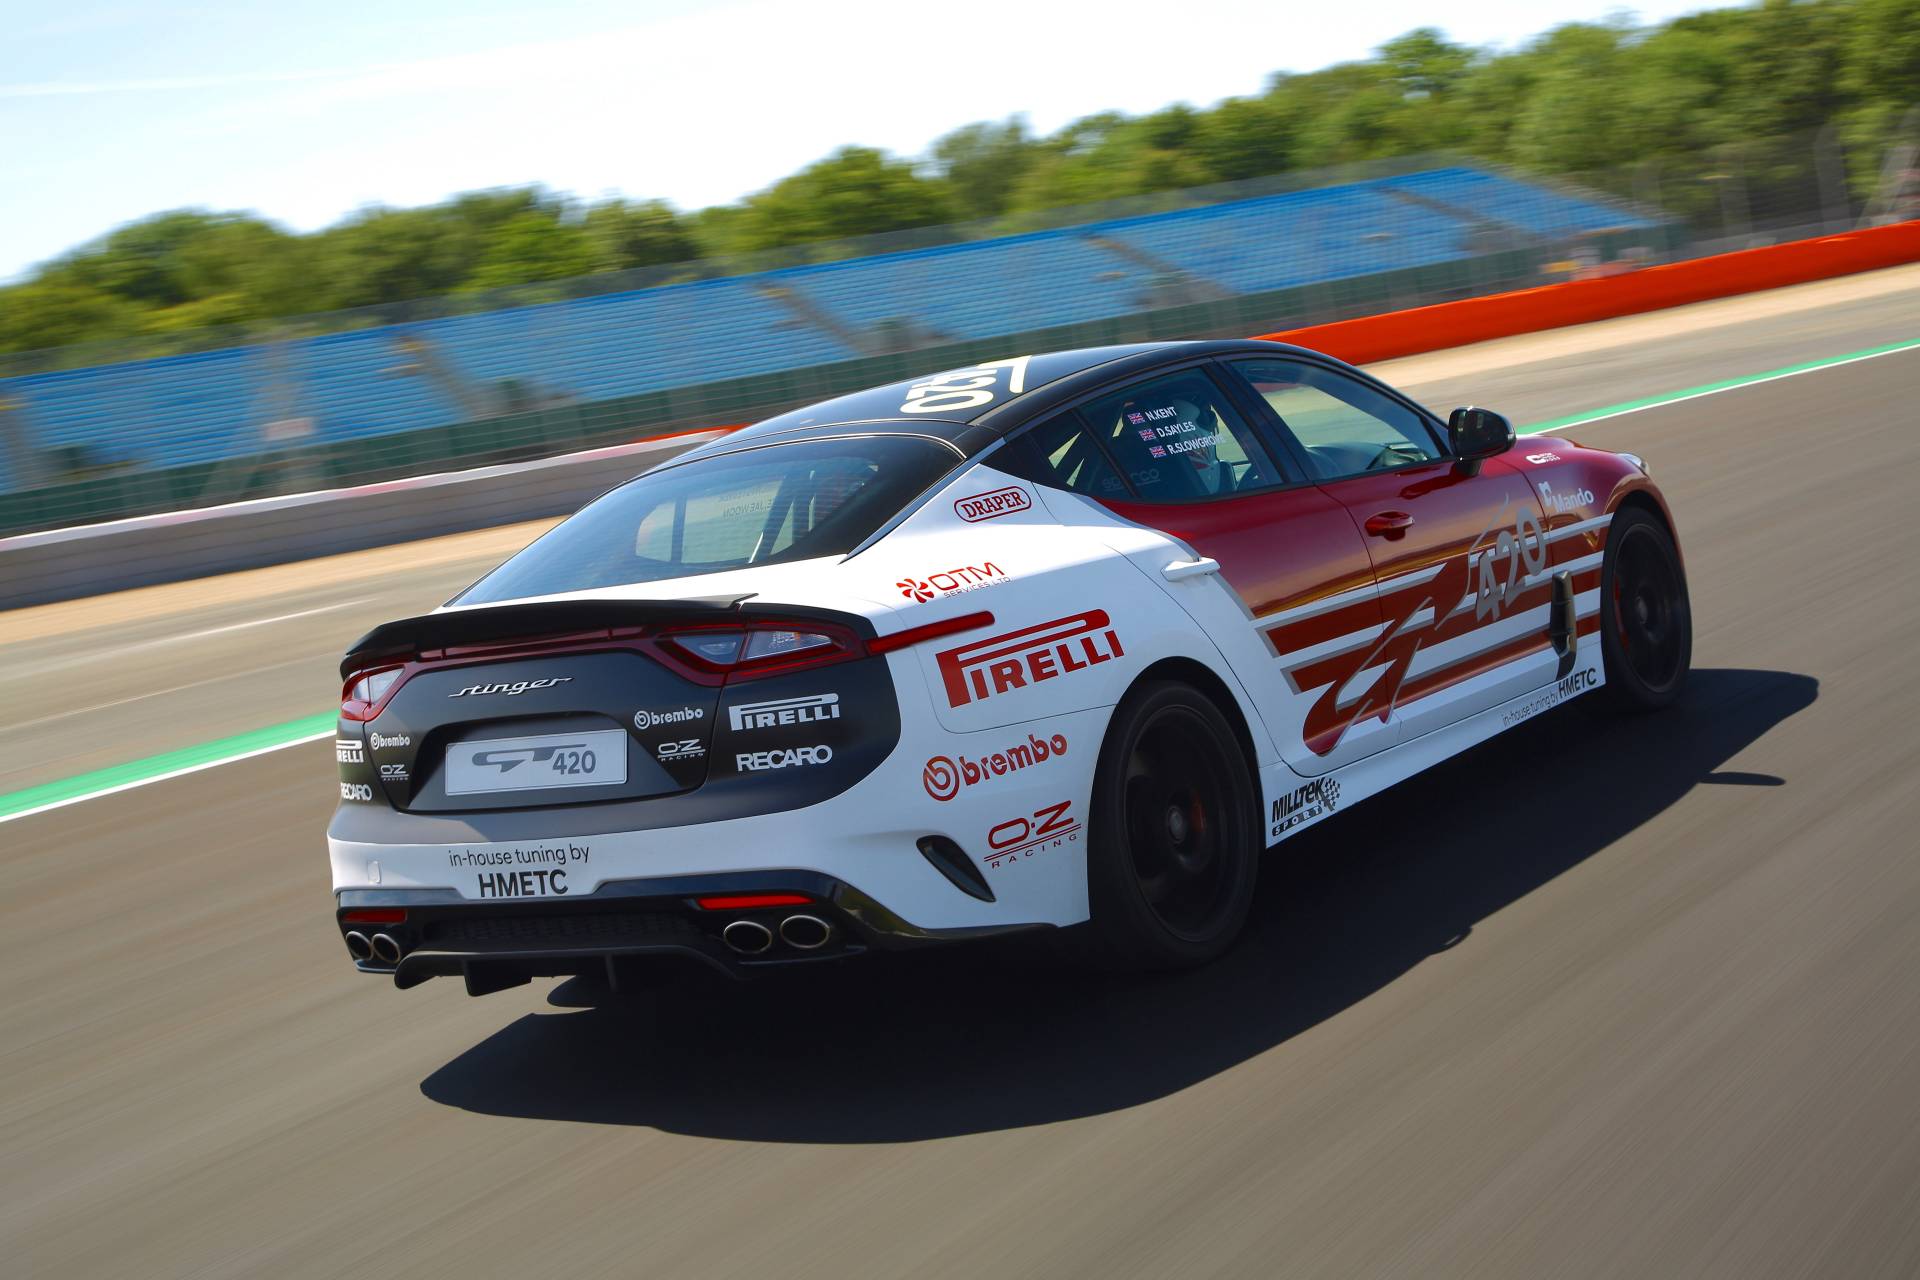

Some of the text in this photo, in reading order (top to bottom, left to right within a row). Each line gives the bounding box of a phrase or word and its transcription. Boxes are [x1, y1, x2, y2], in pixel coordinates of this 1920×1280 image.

[1145, 406, 1177, 421] N.KENT
[1156, 421, 1196, 438] D.SAYLES
[961, 490, 1026, 519] DRAPER
[1552, 487, 1595, 513] Mando
[928, 562, 1005, 591] OTM
[1476, 506, 1547, 622] 420
[943, 576, 1011, 599] SERVICES LTD
[935, 609, 1125, 709] PIRELLI
[448, 677, 573, 698] stinger
[1501, 705, 1532, 728] in-house
[1531, 694, 1552, 712] tuning
[1558, 667, 1597, 698] HMETC
[651, 707, 704, 725] brembo
[728, 693, 840, 732] PIRELLI
[380, 734, 411, 748] brembo
[471, 743, 597, 775] GT 420
[736, 744, 833, 772] RECARO
[958, 734, 1068, 786] brembo
[1272, 805, 1322, 837] SPORT
[449, 843, 590, 867] in-house tuning by
[991, 833, 1077, 869] RACING
[478, 869, 568, 898] HMETC
